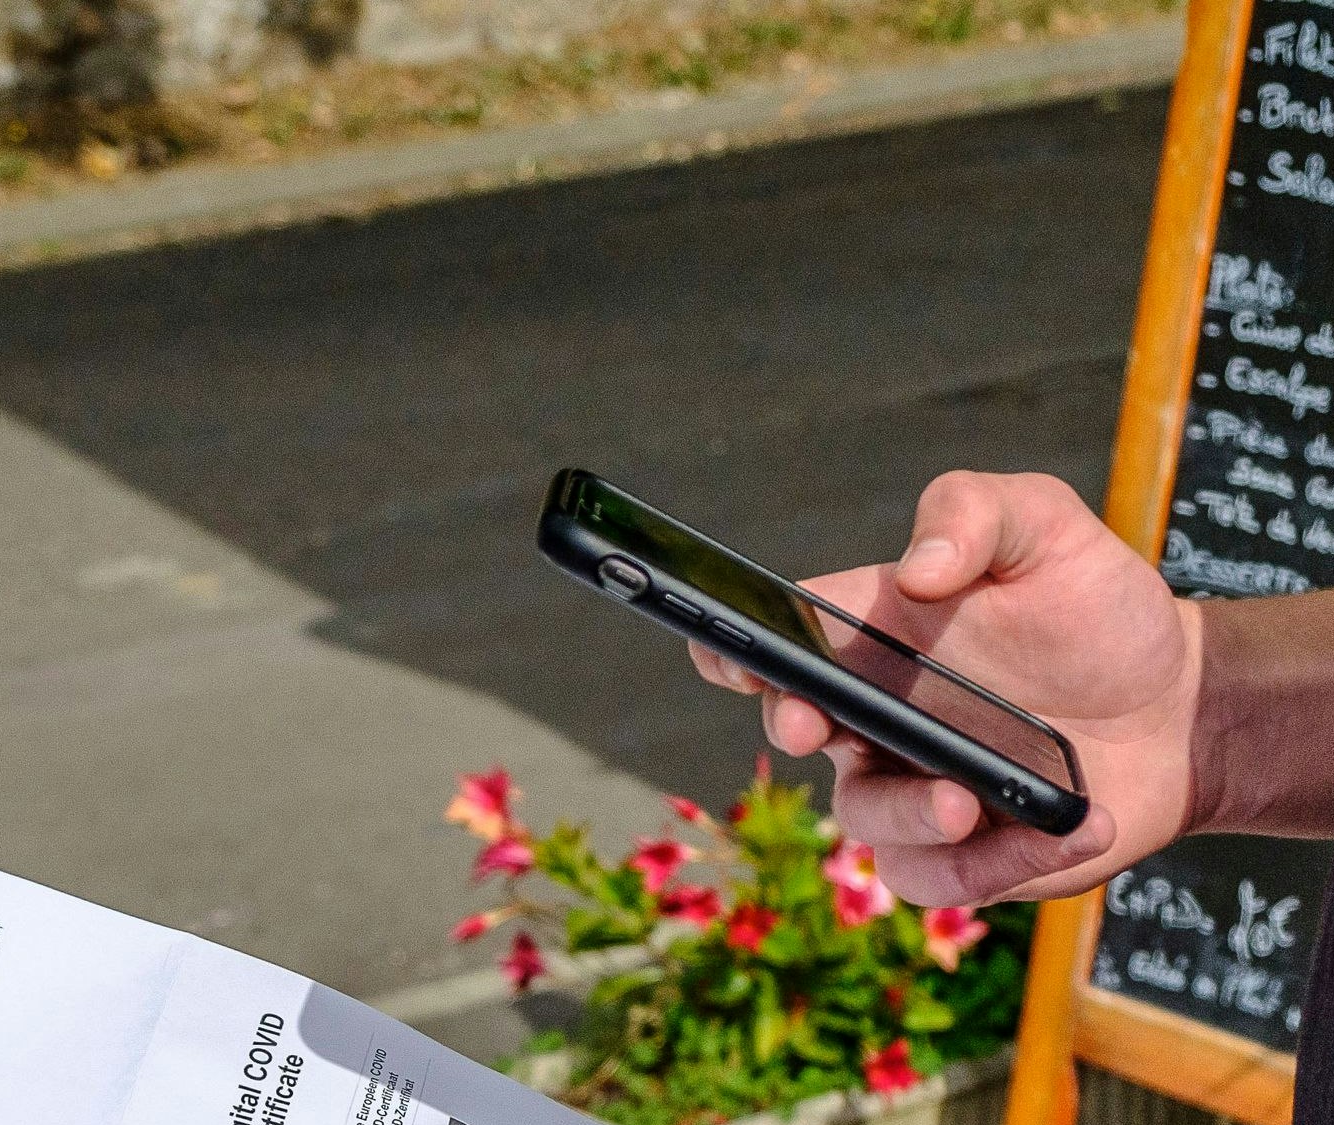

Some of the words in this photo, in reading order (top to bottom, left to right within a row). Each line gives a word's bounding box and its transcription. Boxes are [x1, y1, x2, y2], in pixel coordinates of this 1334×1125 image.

[243, 1013, 284, 1081] COVID
[356, 1077, 379, 1121] Européen
[370, 1048, 386, 1076] COVID
